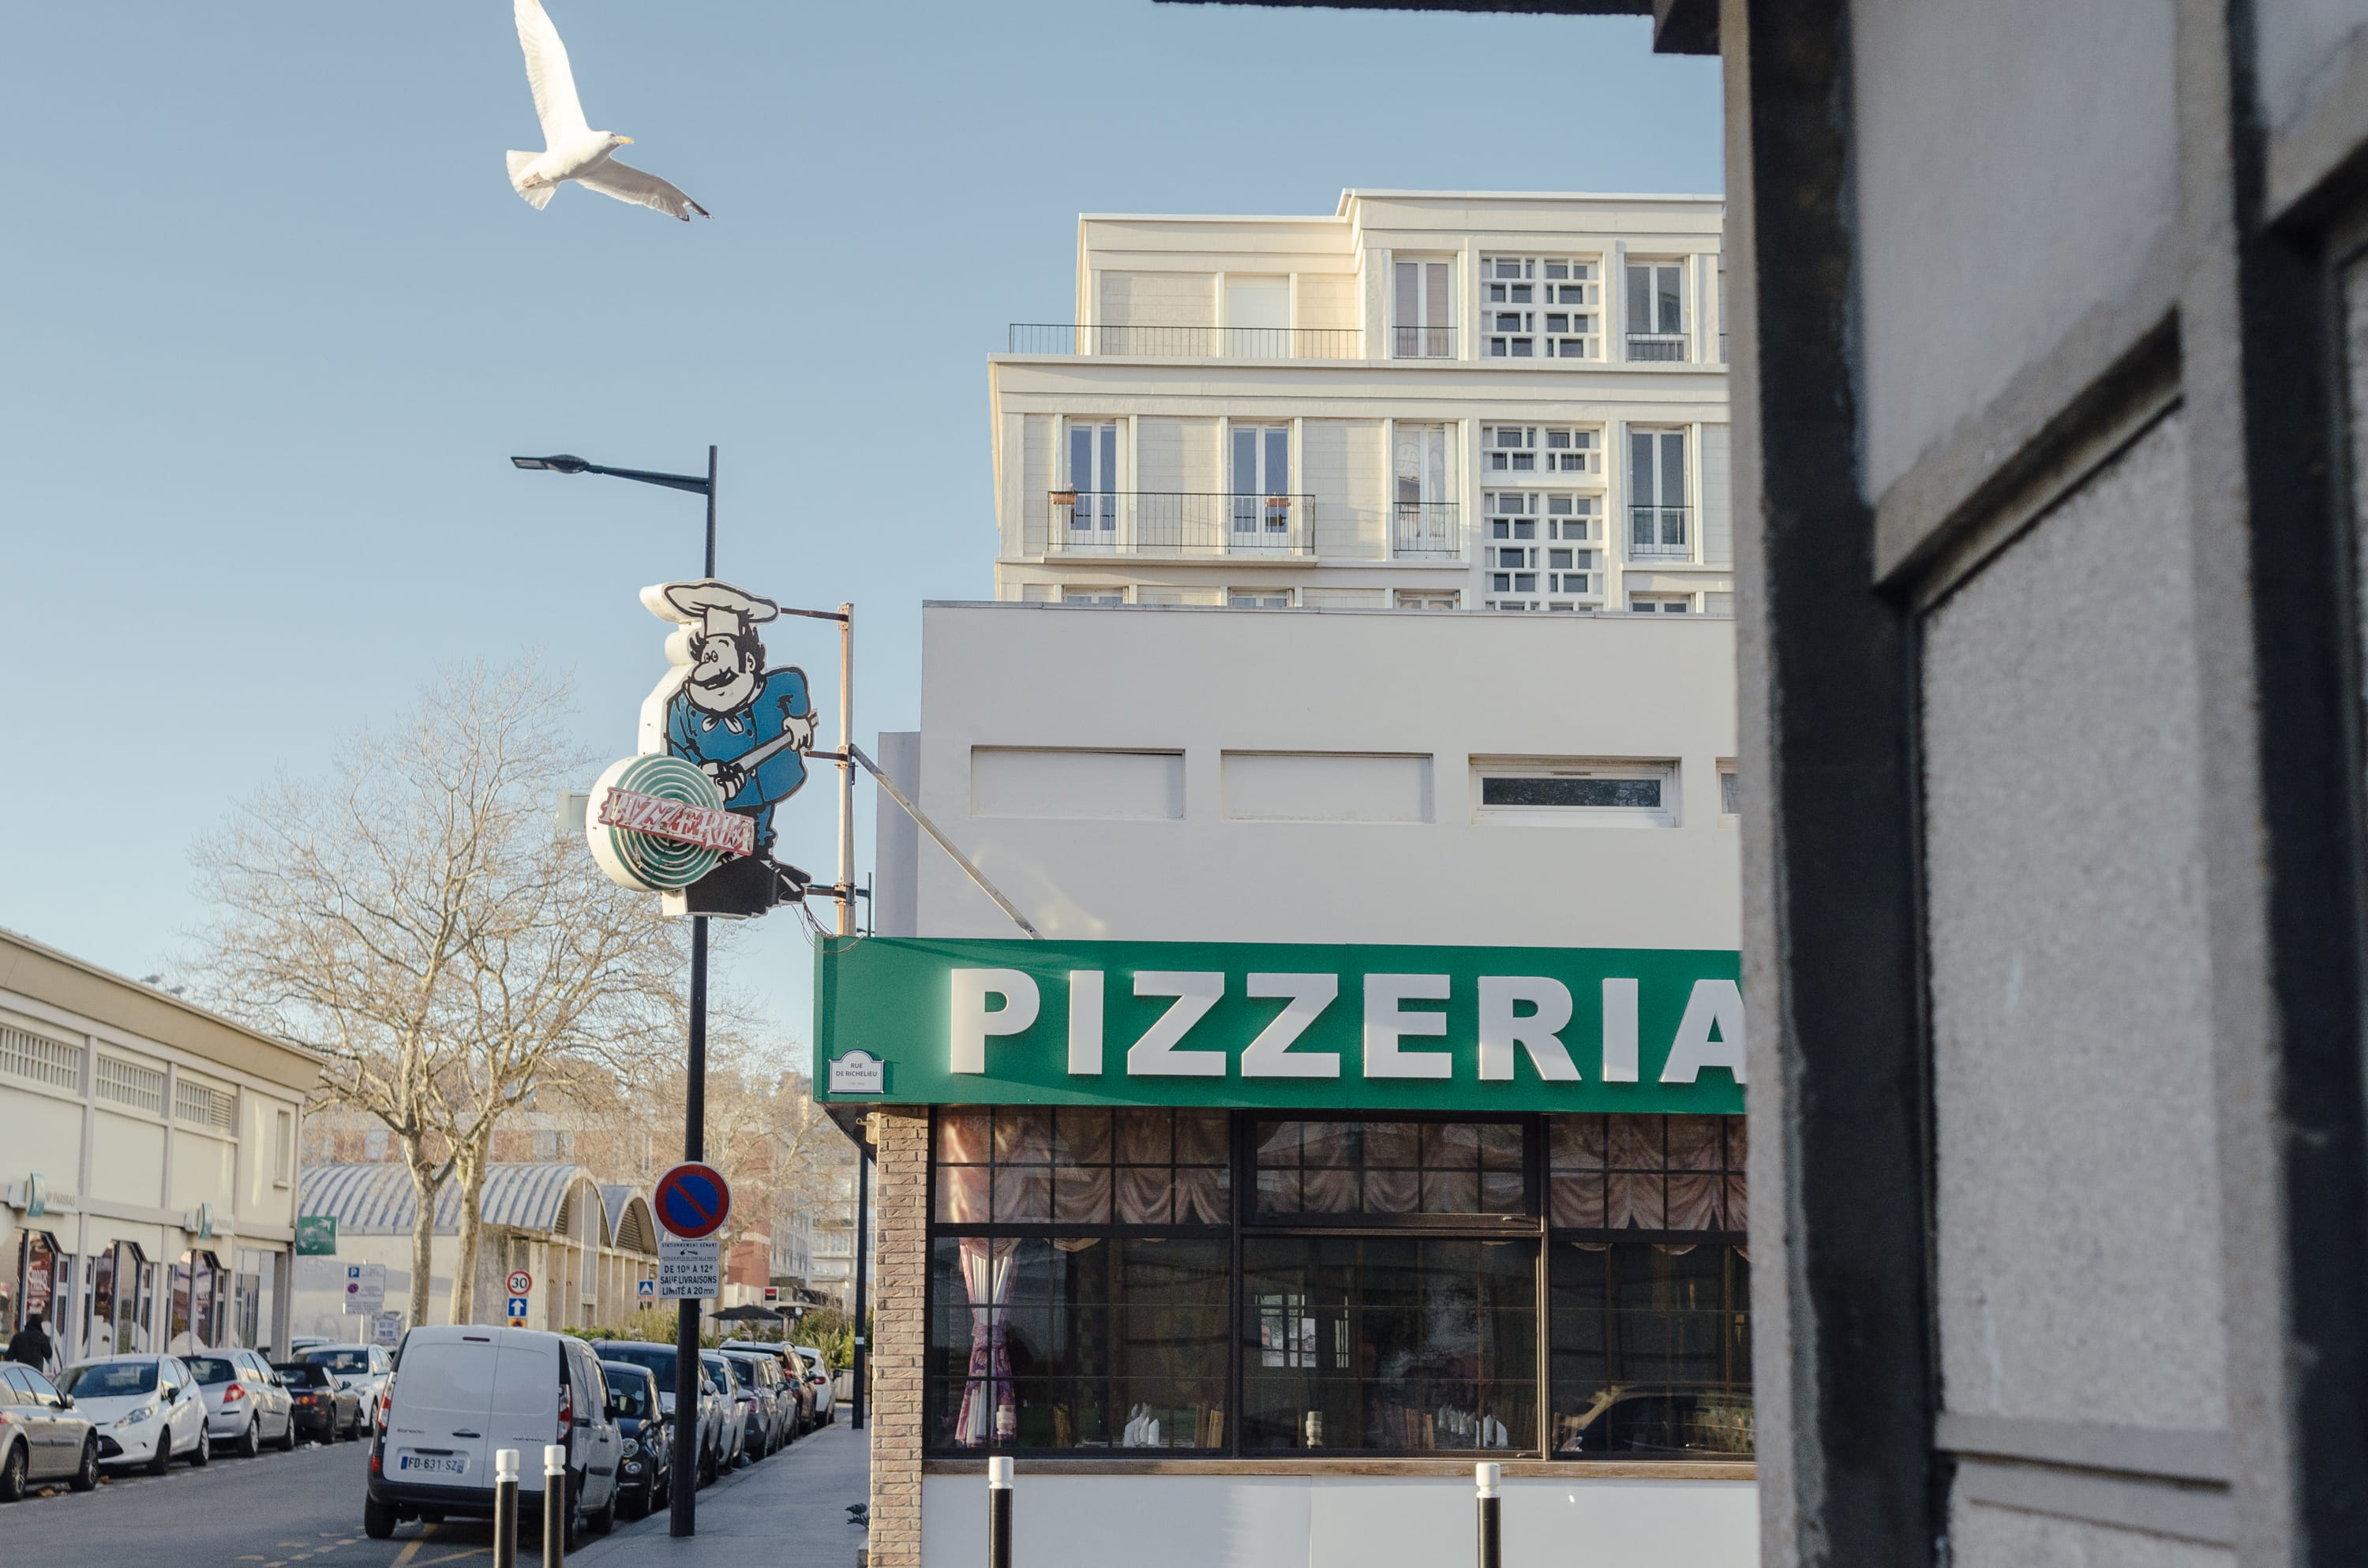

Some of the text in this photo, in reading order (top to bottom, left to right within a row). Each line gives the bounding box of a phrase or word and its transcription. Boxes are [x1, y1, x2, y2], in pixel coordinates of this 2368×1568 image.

[600, 789, 752, 853] PIZZERIA
[950, 968, 1748, 1084] PIZZERIA
[664, 1265, 675, 1274] DE
[511, 1277, 527, 1289] 30
[660, 1275, 717, 1285] SAUF LIVRAISONS
